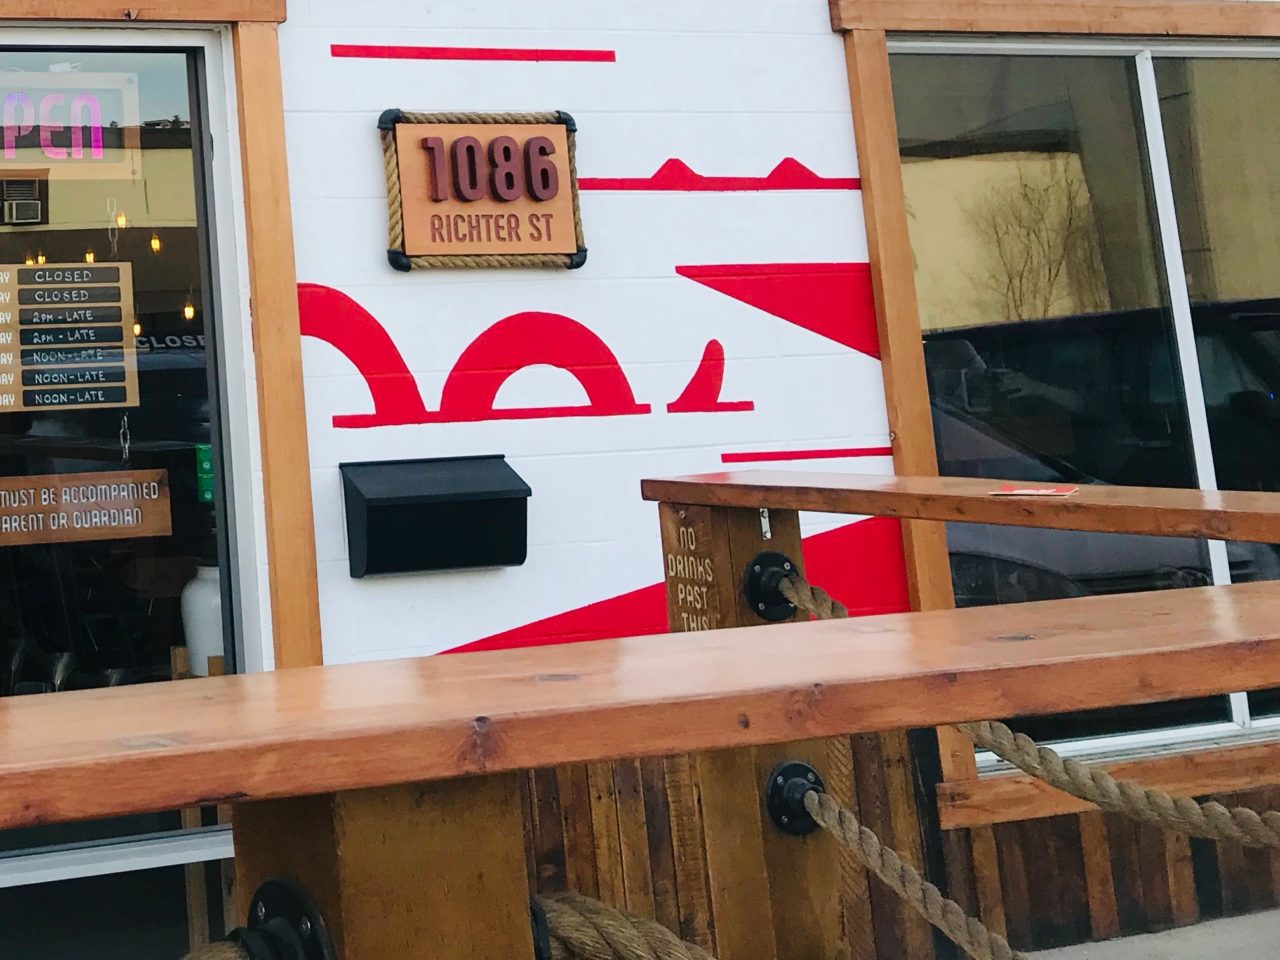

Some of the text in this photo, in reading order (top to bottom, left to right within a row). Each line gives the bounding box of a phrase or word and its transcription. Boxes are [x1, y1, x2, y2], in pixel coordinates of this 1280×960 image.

[421, 135, 559, 203] 1086
[430, 213, 554, 243] RICHTER ST
[34, 270, 92, 282] CLOSED
[34, 290, 89, 302] CLOSED
[65, 310, 94, 322] LATE
[67, 329, 96, 341] LATE
[41, 487, 57, 506] BE
[61, 482, 160, 503] ACCOMPANIED
[50, 512, 69, 529] OR
[73, 507, 143, 528] GUARDIAN
[679, 527, 696, 551] NO
[667, 554, 714, 582] DRINKS
[677, 584, 708, 609] PAST
